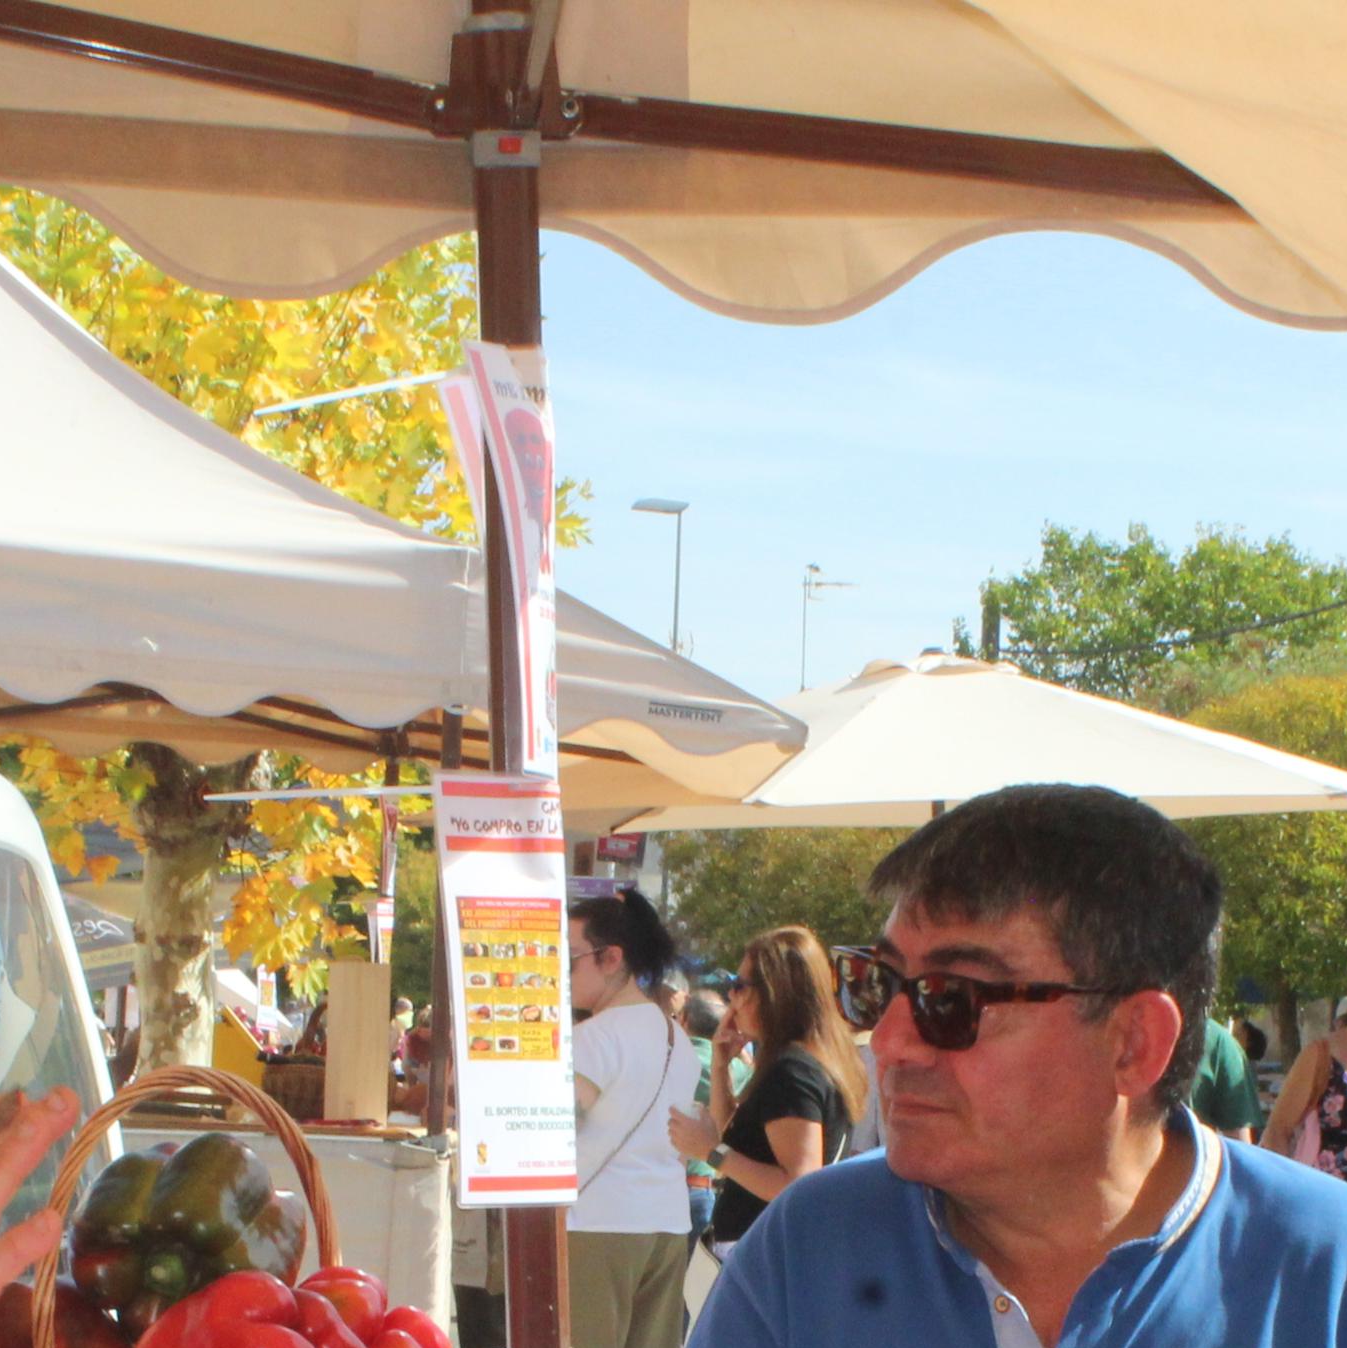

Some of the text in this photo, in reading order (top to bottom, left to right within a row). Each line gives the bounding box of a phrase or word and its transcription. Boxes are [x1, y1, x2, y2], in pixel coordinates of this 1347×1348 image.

[648, 706, 723, 724] MASTERTENT
[473, 818, 522, 834] COMPRO
[526, 819, 545, 833] EN
